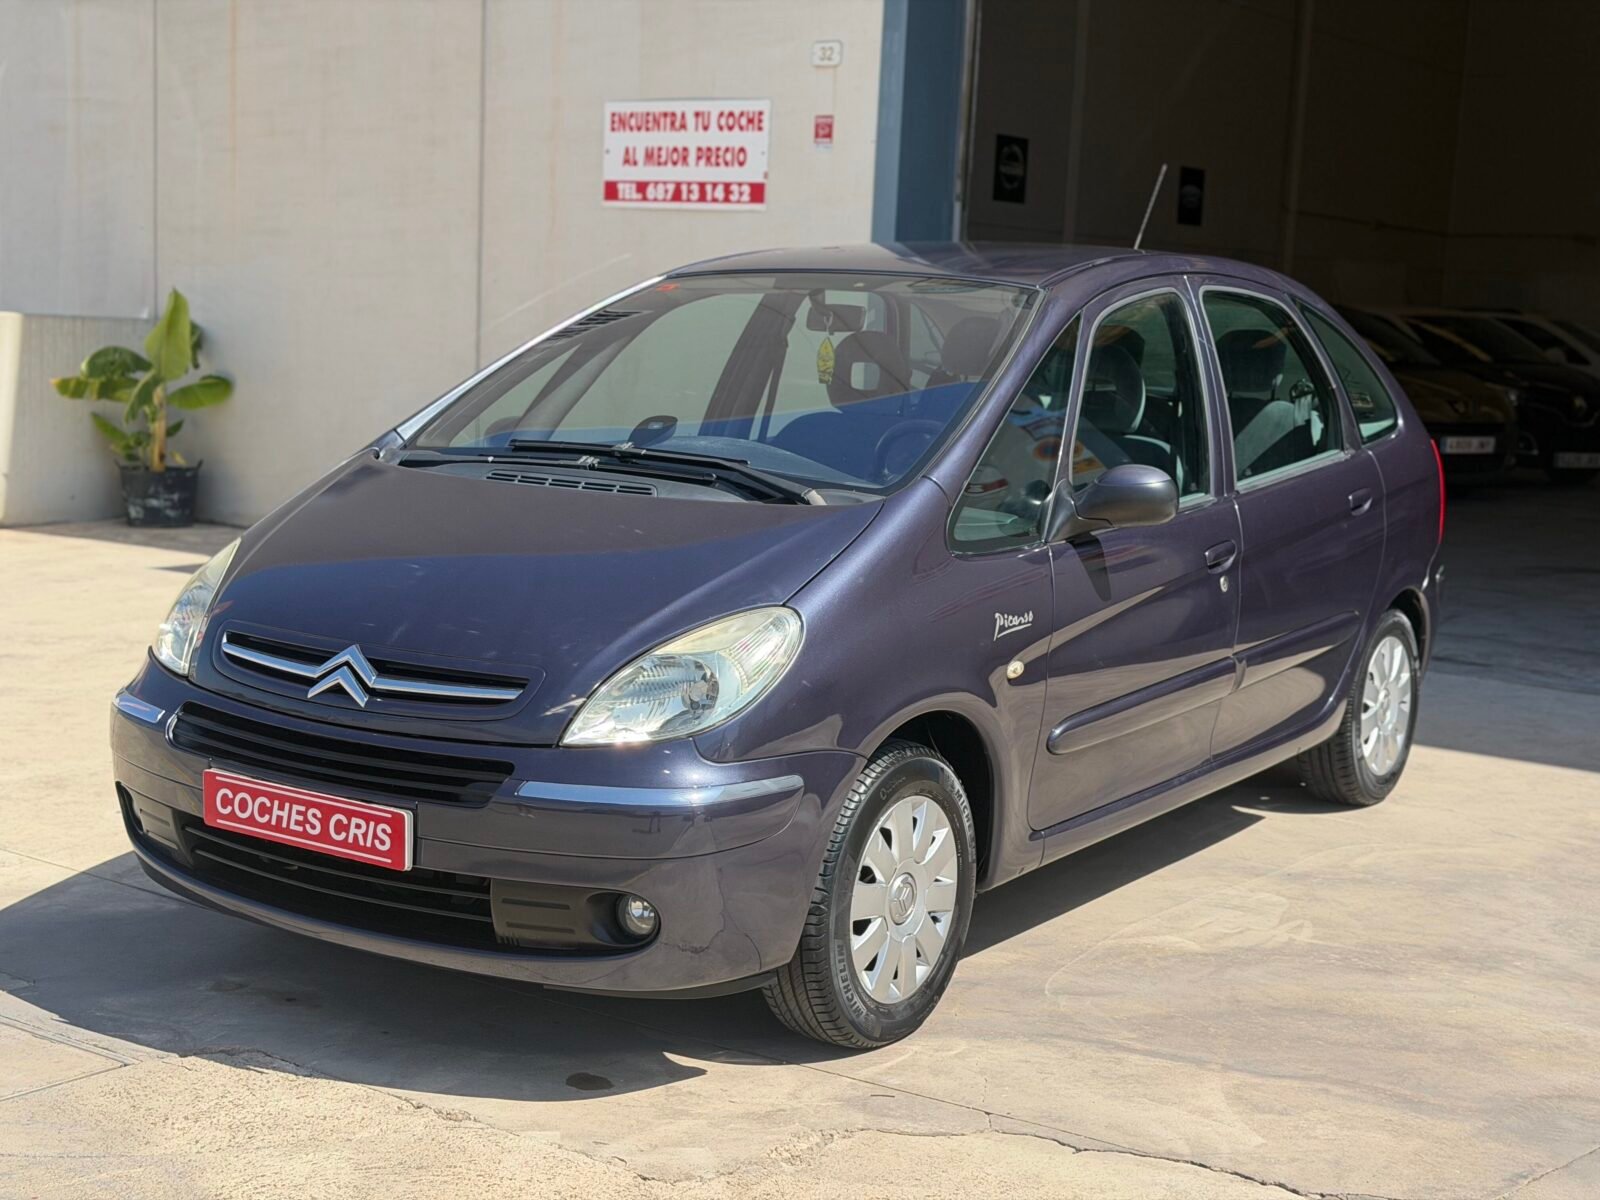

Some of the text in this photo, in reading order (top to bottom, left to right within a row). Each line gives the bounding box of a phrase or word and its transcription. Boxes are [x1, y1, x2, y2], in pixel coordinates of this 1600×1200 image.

[819, 45, 834, 62] 32
[610, 110, 764, 132] ENCUENTRA TU COCHE
[622, 146, 747, 168] AL MEJOR PRECIO
[617, 182, 642, 200] TEL.
[680, 183, 700, 201] 13
[705, 184, 725, 202] 14
[729, 184, 751, 202] 32
[216, 788, 392, 851] COCHES CRIS
[837, 944, 864, 1018] MICHELIN
